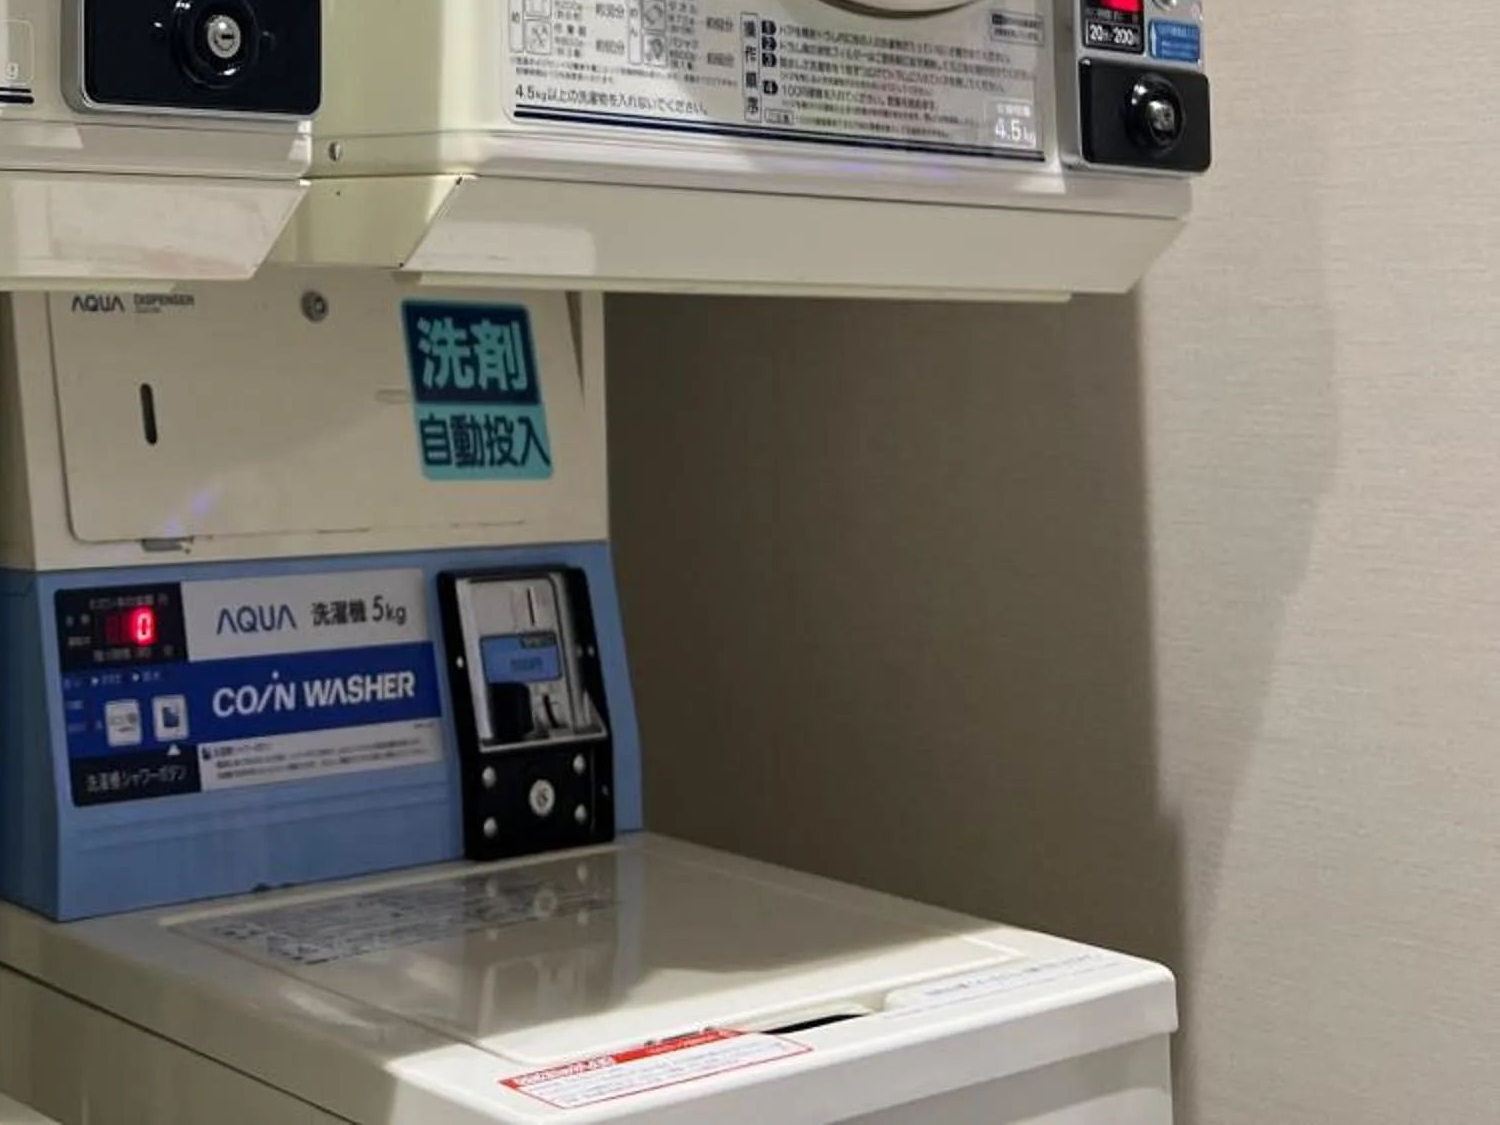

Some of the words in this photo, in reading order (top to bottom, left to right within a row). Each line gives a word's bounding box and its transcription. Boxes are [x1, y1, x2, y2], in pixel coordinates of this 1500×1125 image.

[416, 317, 529, 392] 洗剤
[420, 415, 552, 468] 自動投入
[136, 611, 152, 641] 0
[216, 604, 297, 635] AQUA
[311, 600, 368, 628] 洗濯機
[372, 595, 407, 625] 5kg
[303, 670, 416, 709] WASHER
